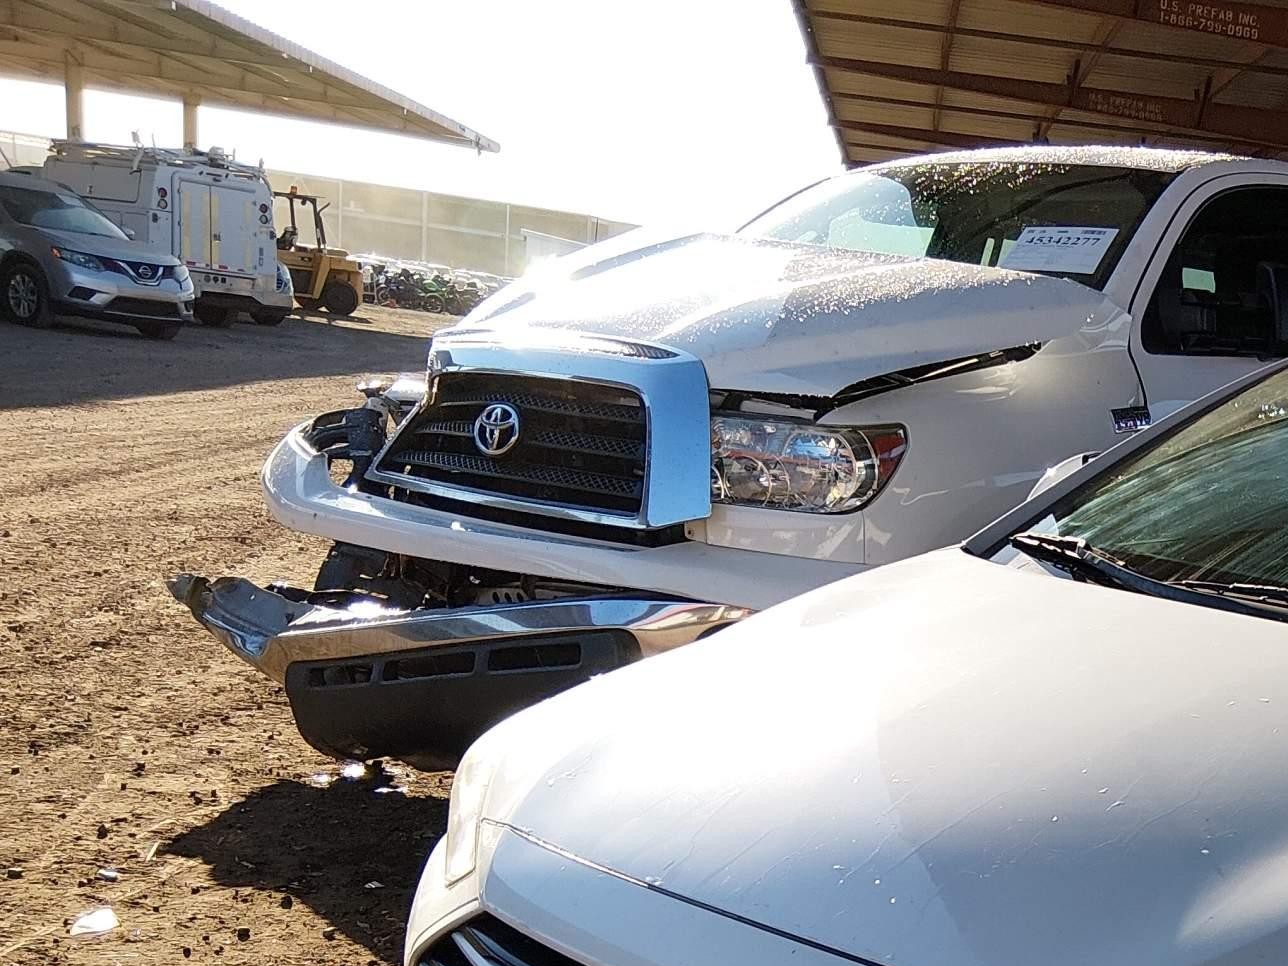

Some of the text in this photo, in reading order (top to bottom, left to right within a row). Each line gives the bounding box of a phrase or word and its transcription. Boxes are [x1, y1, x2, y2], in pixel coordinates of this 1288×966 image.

[1160, 0, 1260, 28] U.S. PREFAB INC.
[1160, 11, 1259, 40] 1-866-799-0969
[1025, 236, 1101, 247] 45342277
